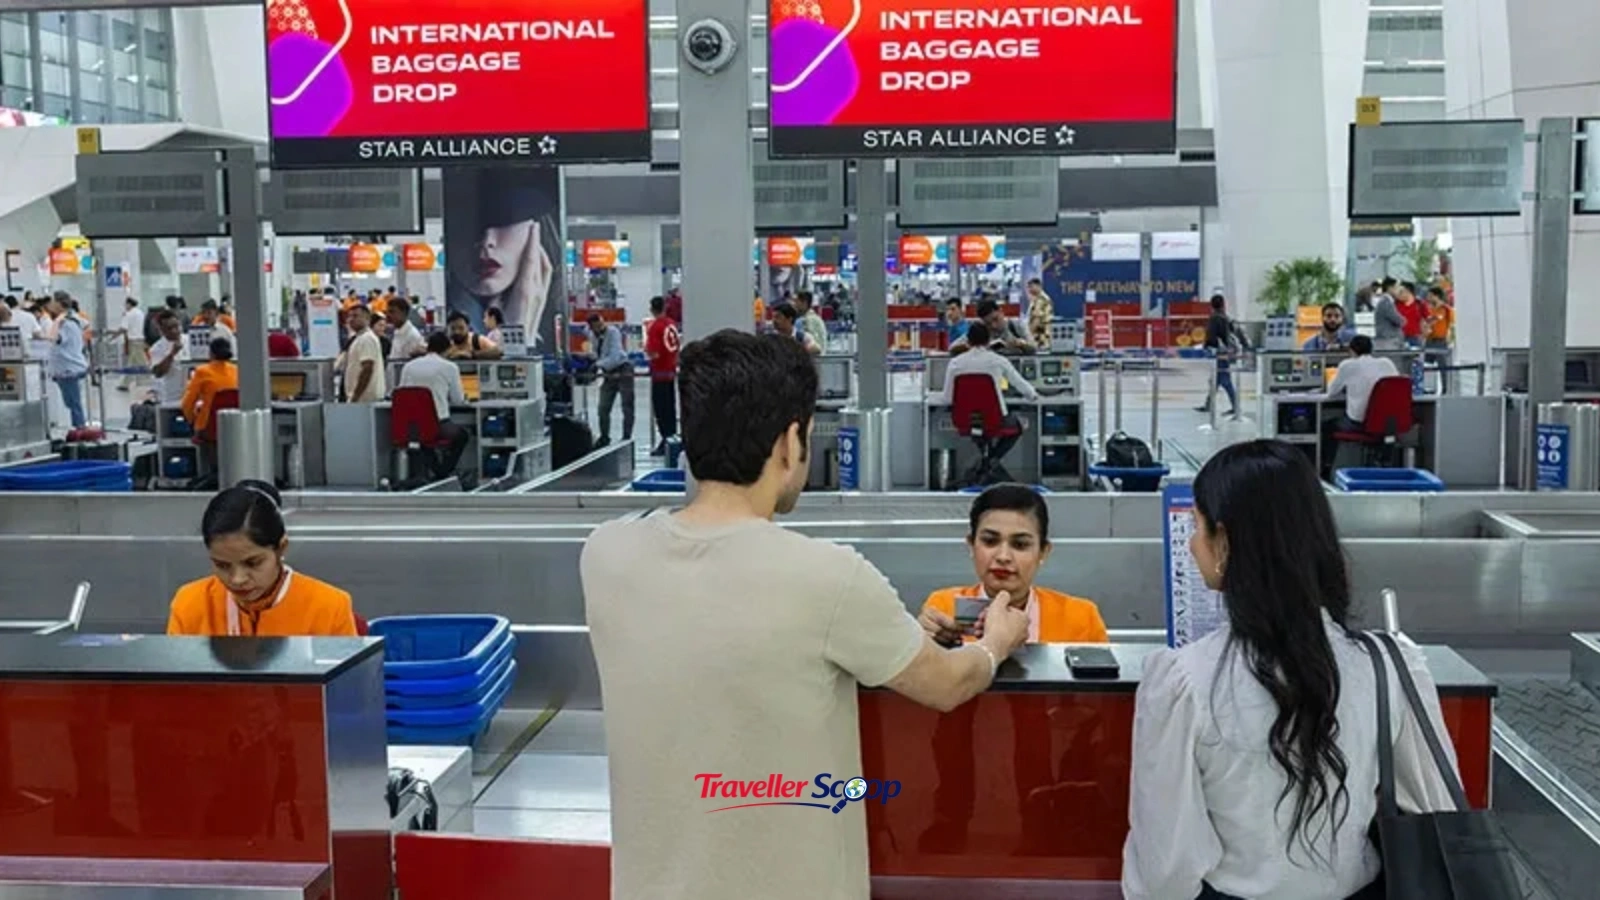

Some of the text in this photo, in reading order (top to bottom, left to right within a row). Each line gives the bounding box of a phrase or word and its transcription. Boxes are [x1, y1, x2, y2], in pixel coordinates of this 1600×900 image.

[880, 6, 1142, 30] INTERNATIONAL
[371, 20, 614, 44] INTERNATIONAL
[880, 38, 1040, 61] BAGGAGE
[372, 52, 520, 74] BAGGAGE
[881, 71, 971, 91] DROP
[373, 83, 457, 103] DROP
[359, 137, 531, 158] STAR ALLIANCE
[863, 127, 1047, 147] STAR ALLIANCE
[1061, 281, 1083, 294] THE
[1166, 280, 1195, 293] NEW
